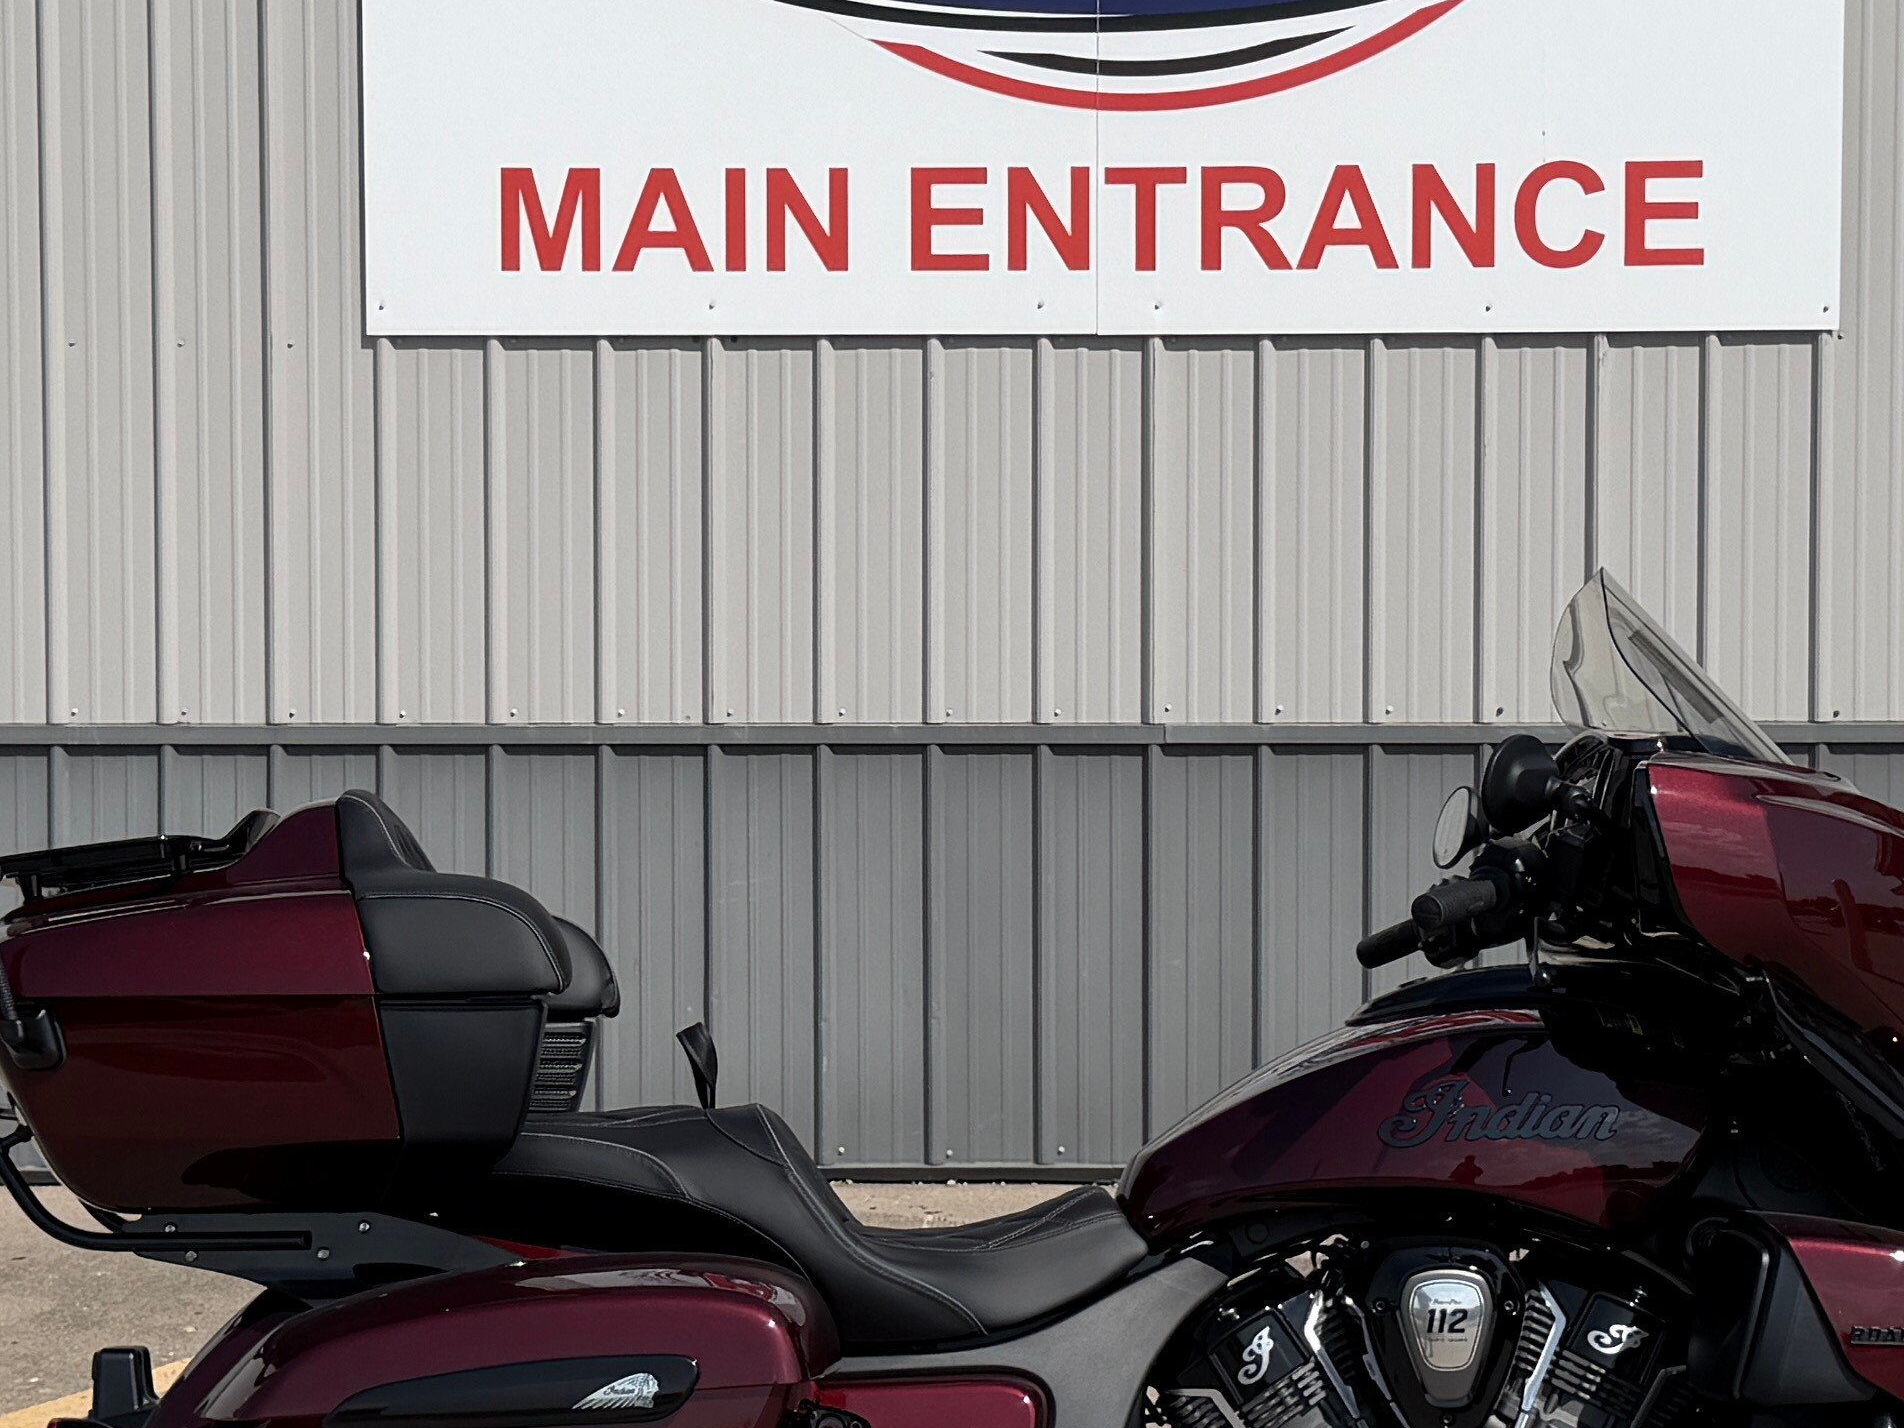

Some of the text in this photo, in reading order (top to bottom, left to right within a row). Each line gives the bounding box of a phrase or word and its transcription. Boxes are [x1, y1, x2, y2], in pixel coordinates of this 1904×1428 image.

[498, 159, 1706, 272] MAIN ENTRANCE
[1377, 1078, 1621, 1149] Indian
[1426, 1308, 1468, 1334] 112
